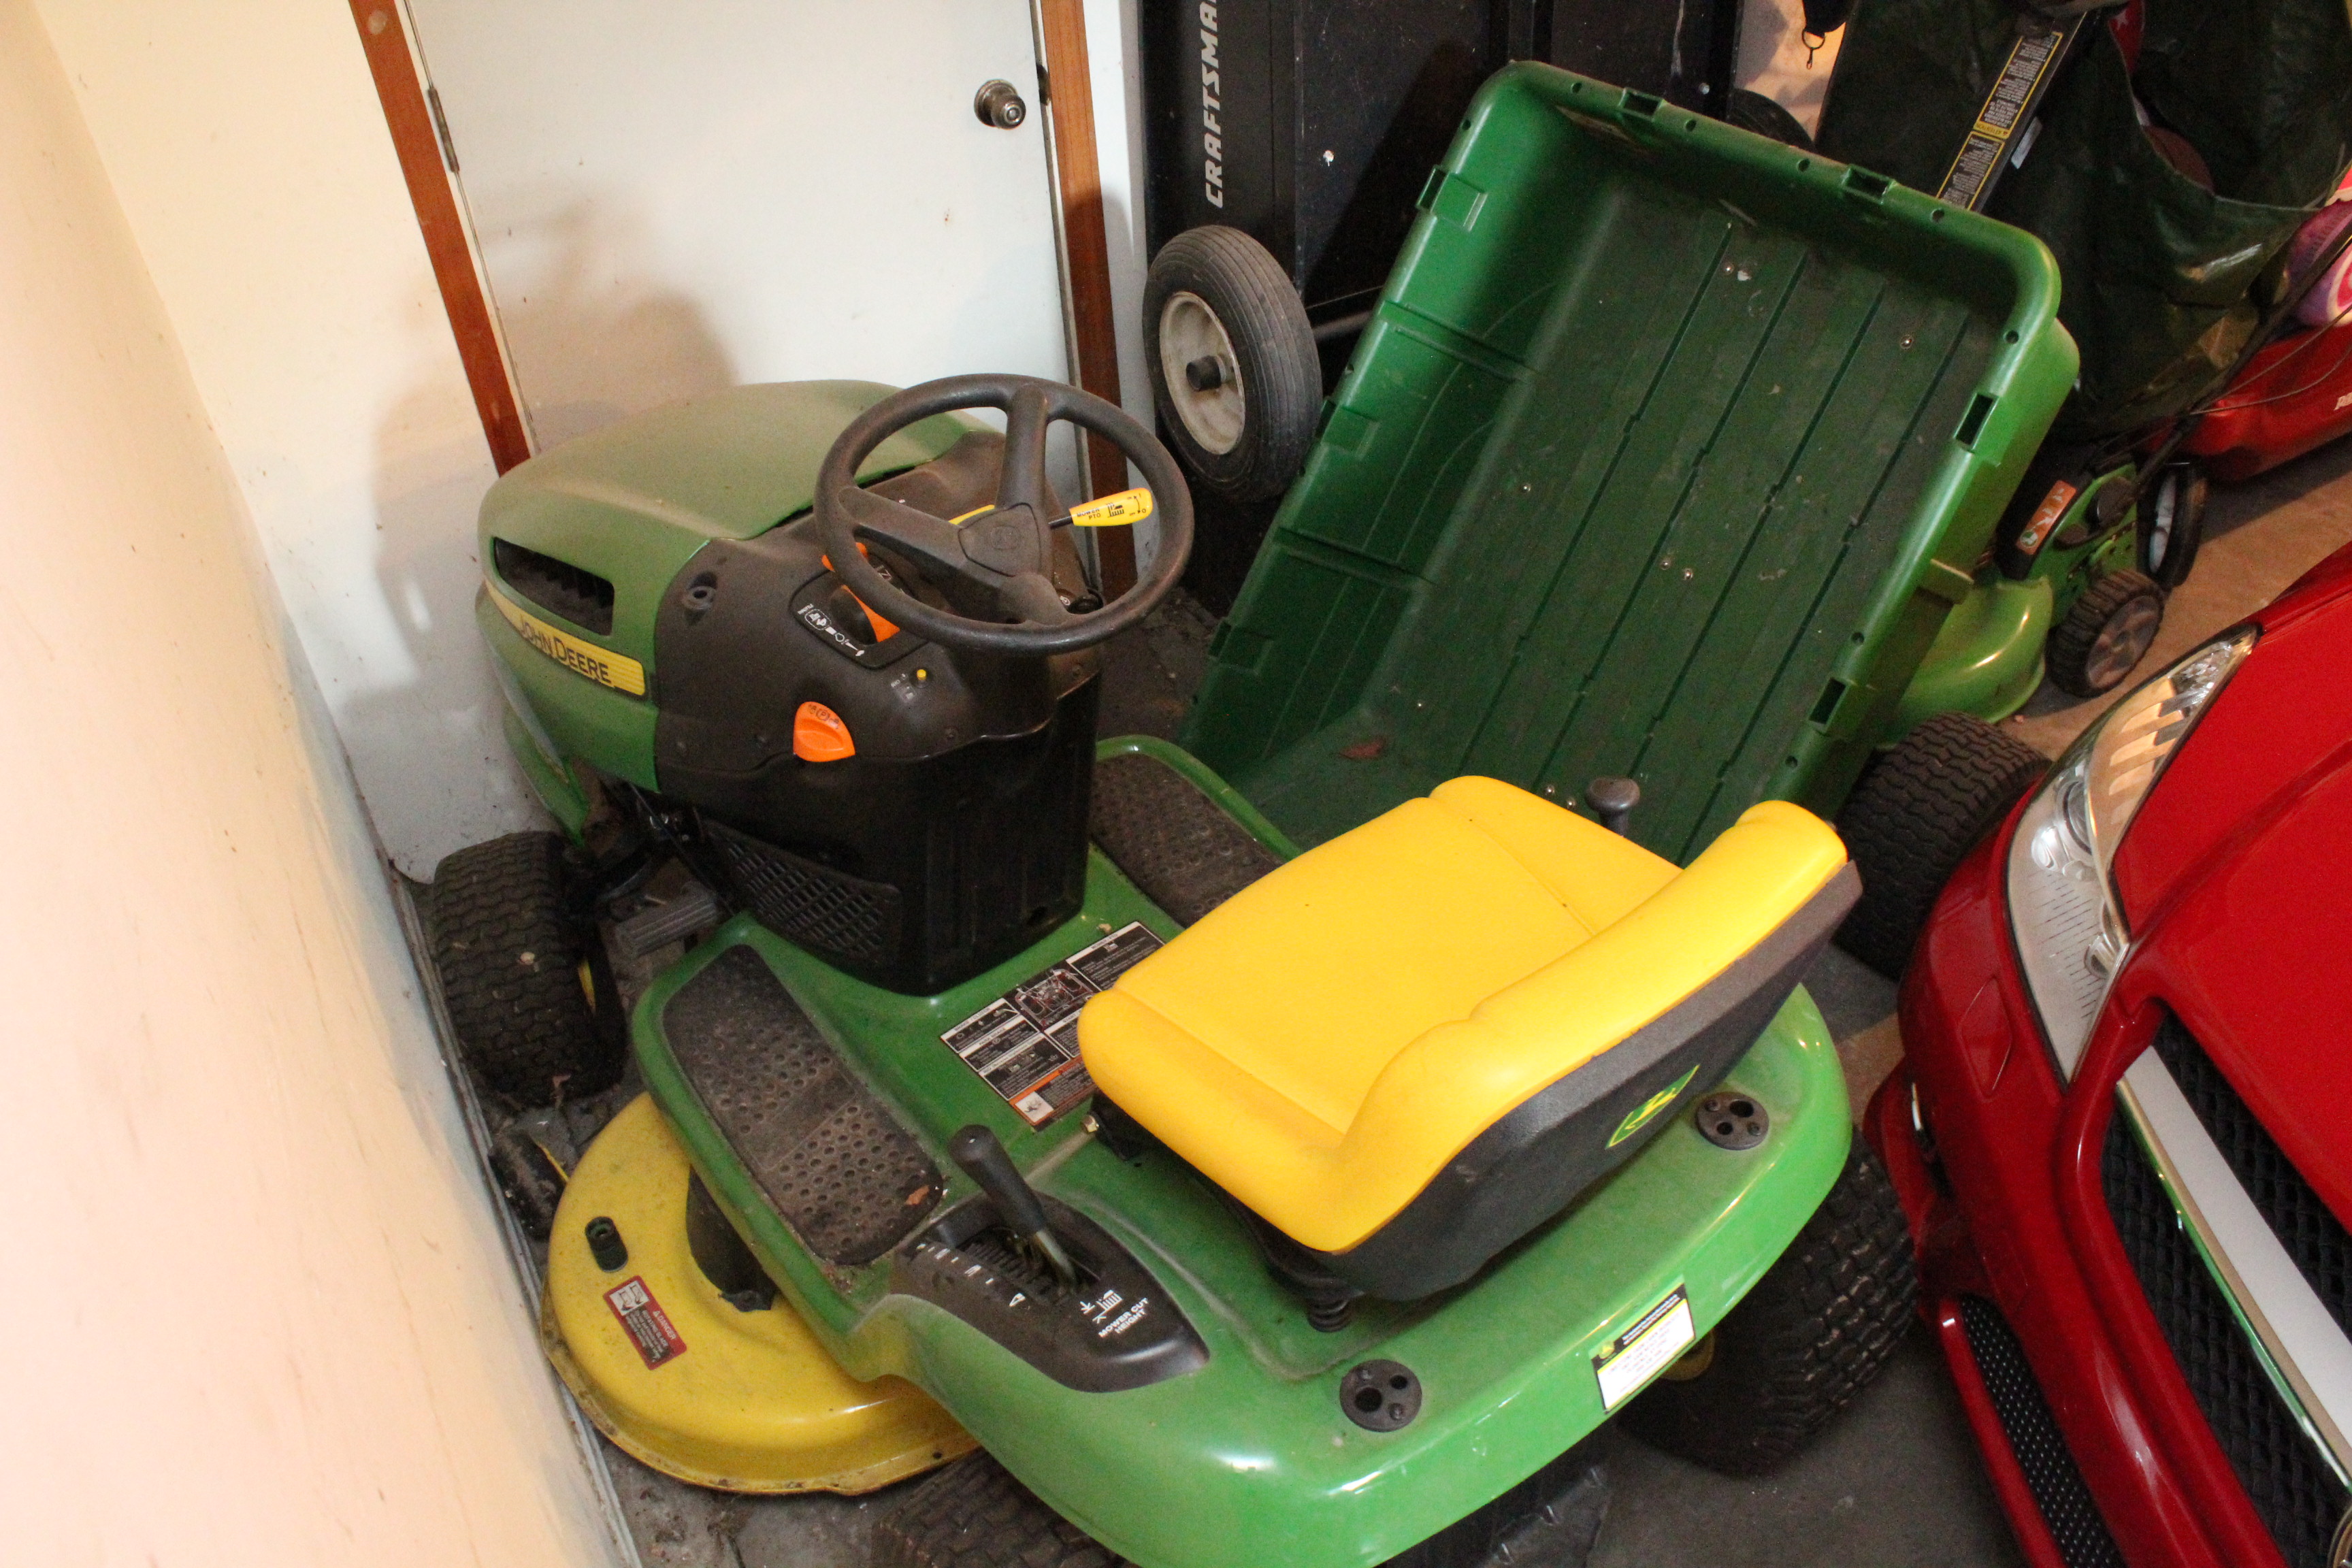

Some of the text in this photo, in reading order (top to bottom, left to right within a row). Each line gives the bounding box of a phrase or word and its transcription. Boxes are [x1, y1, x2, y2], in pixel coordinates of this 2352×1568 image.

[1199, 0, 1224, 209] CRAFTSMA
[1077, 508, 1100, 517] MOWER
[520, 614, 612, 684] JOHN DEERE
[1009, 1292, 1026, 1307] 4
[657, 1315, 676, 1339] DANGER
[1098, 1297, 1149, 1338] MOWER CUT
[1114, 1307, 1147, 1334] HEIGHT
